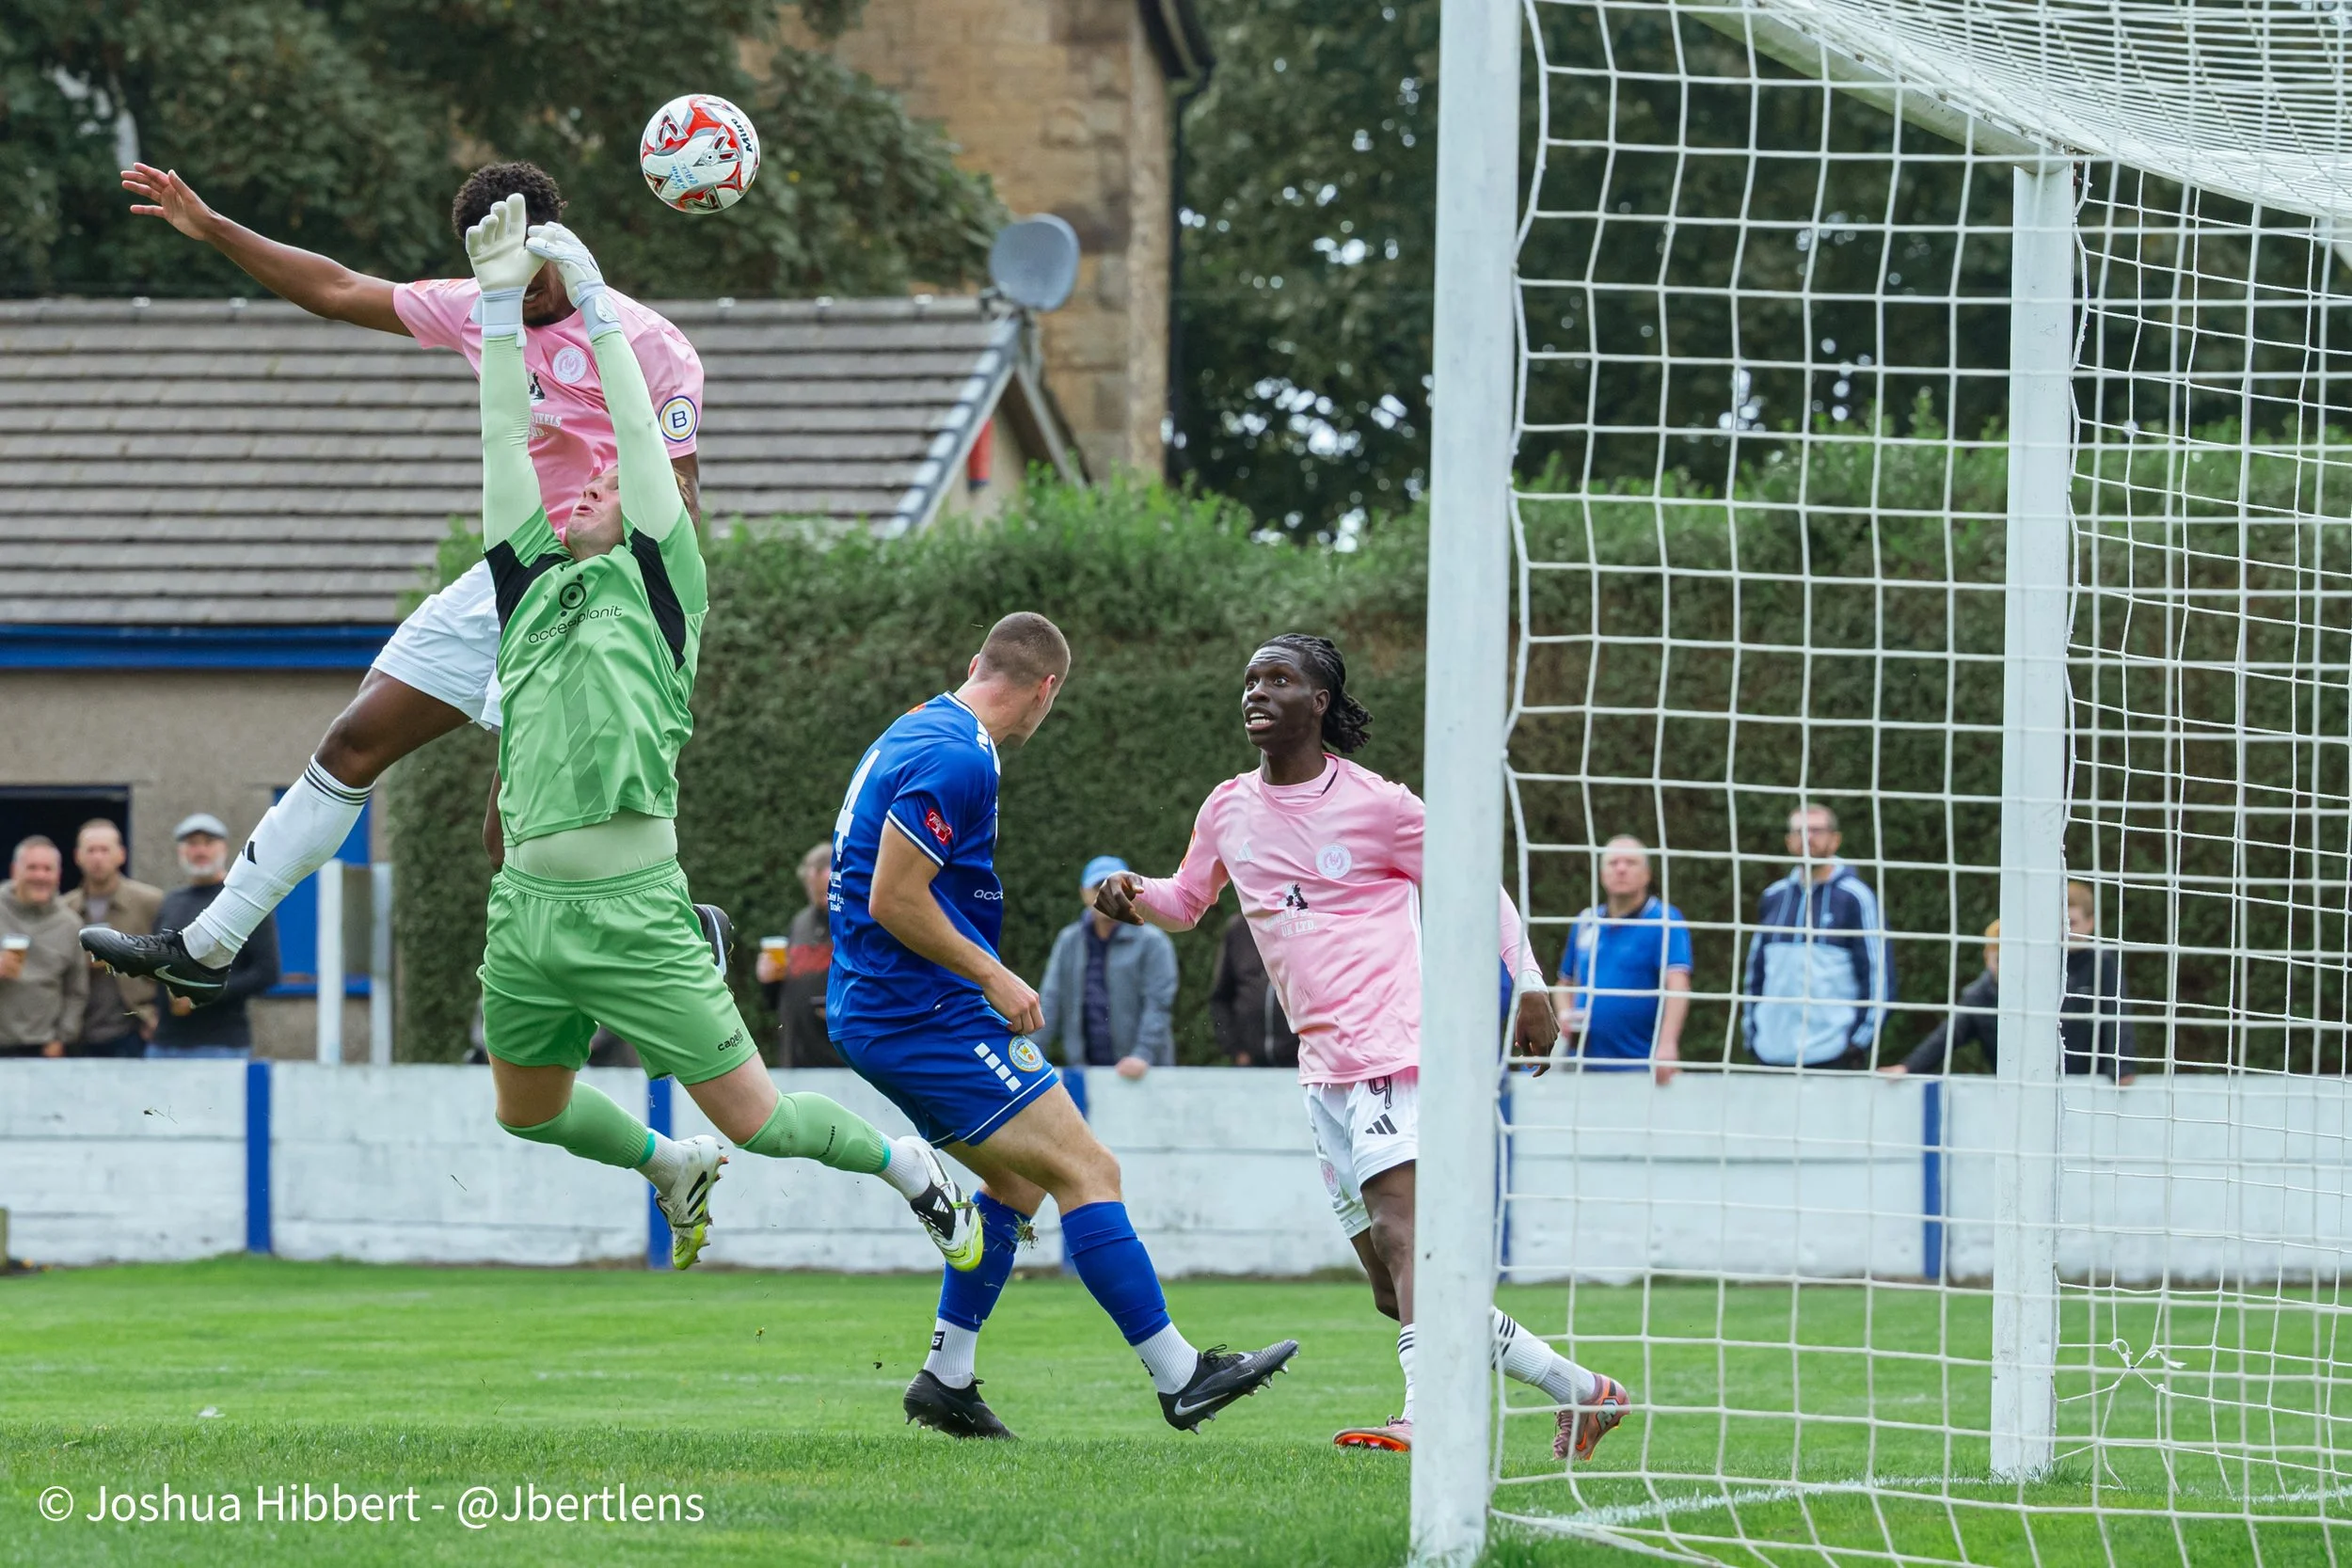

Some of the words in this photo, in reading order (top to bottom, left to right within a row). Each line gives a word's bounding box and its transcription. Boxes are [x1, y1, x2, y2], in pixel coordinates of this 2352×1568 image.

[672, 411, 687, 428] B
[528, 605, 623, 644] acceplanit
[835, 749, 881, 862] 4
